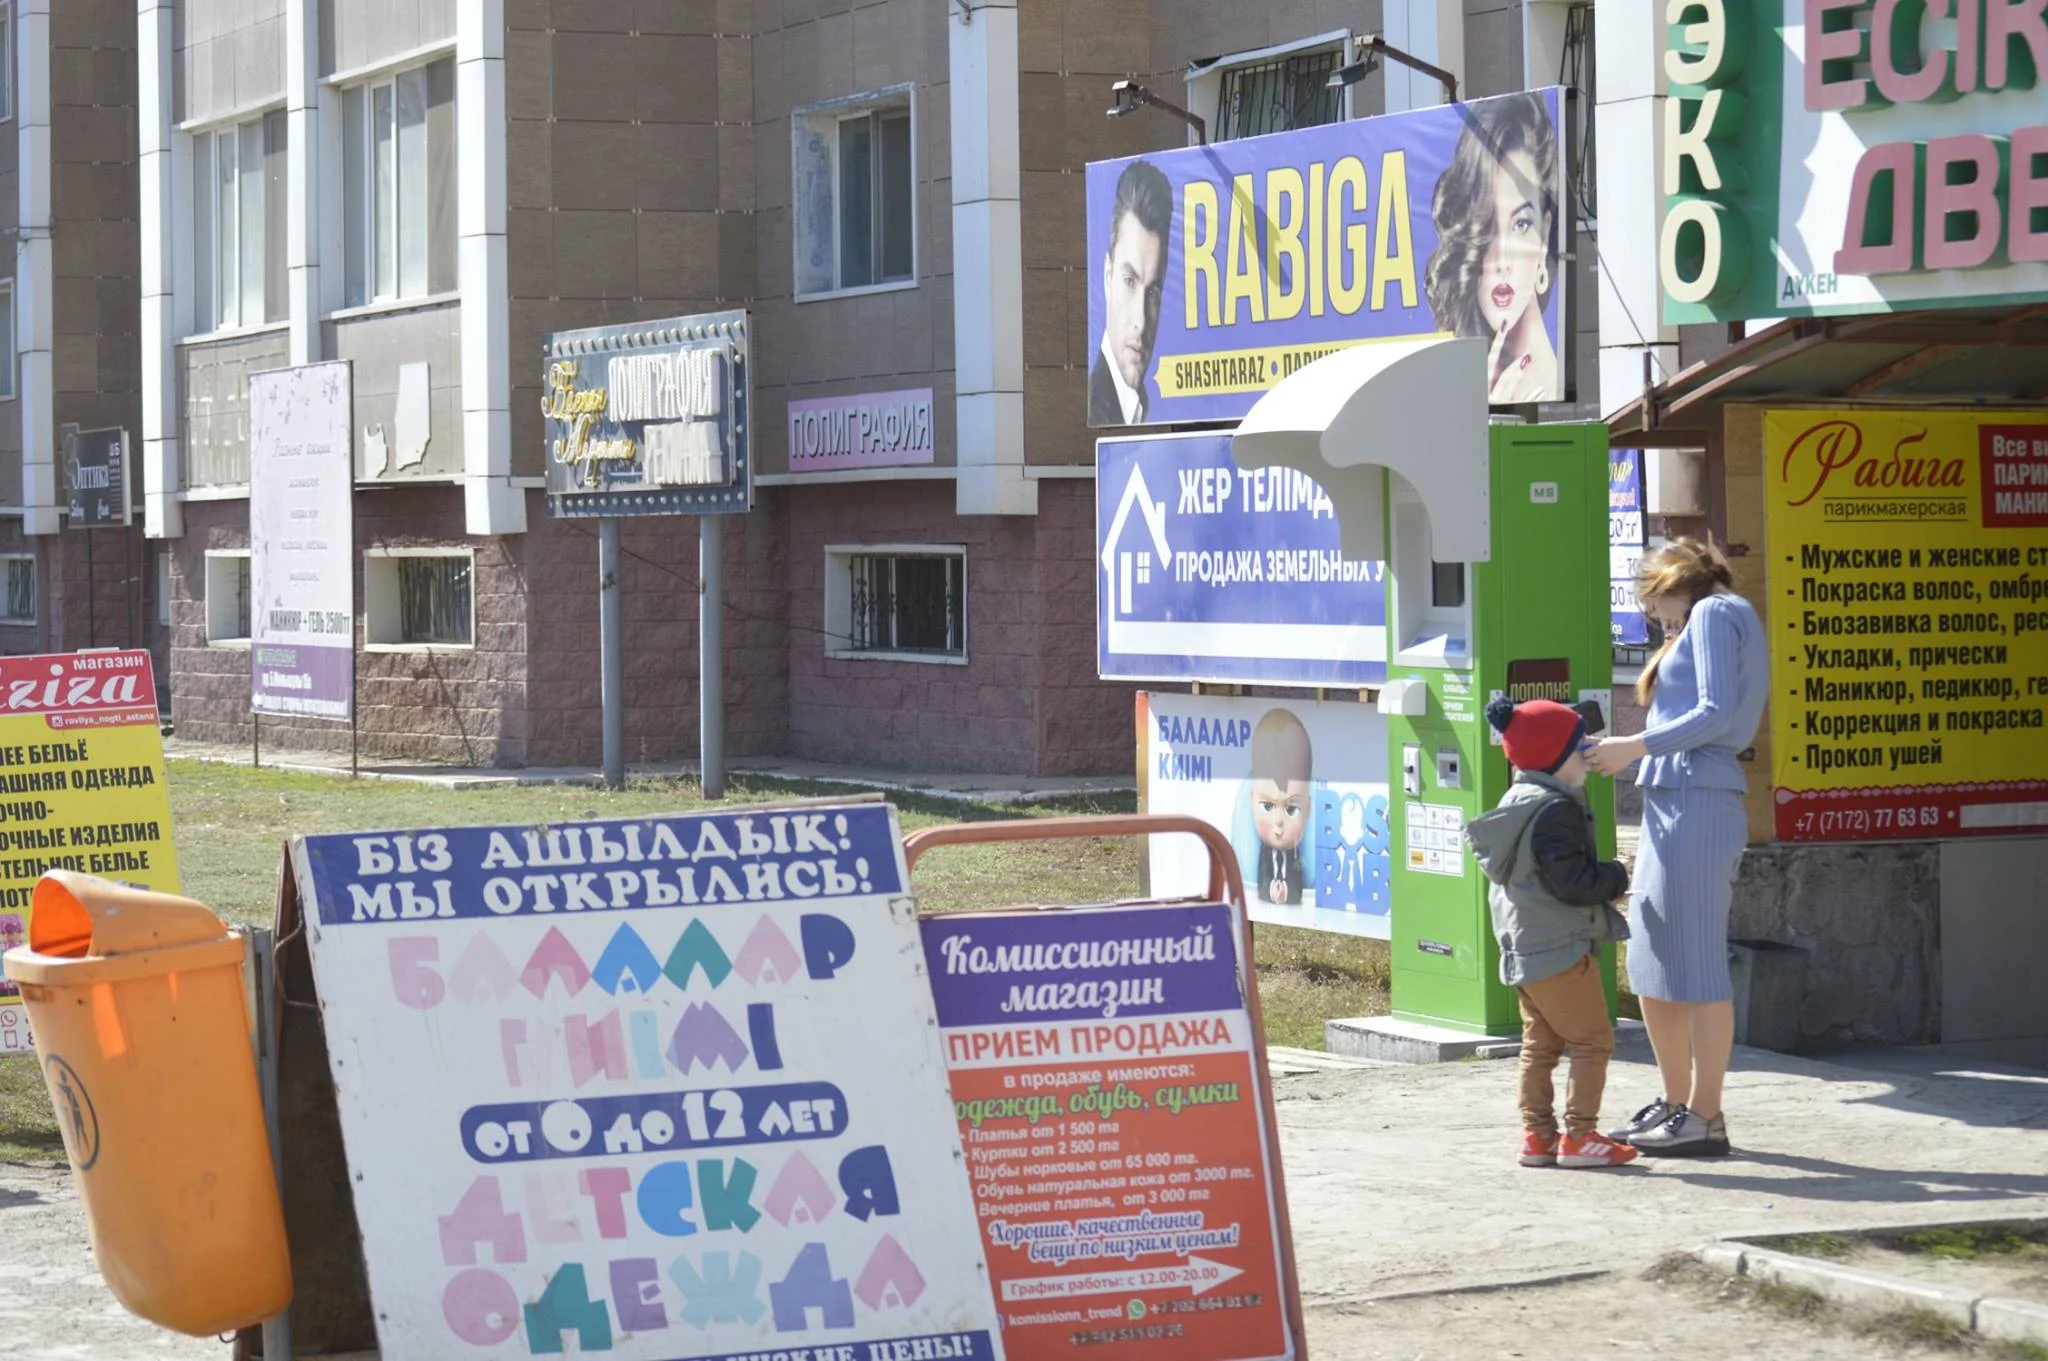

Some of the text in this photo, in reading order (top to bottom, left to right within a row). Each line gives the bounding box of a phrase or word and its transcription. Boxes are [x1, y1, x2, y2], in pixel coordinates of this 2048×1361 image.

[1660, 0, 1726, 303] ЭКО
[1183, 150, 1418, 330] RABIGA
[1176, 355, 1265, 389] SHASHTARAZ
[791, 402, 931, 458] ПОЛИГРАФИЯ
[1993, 434, 2027, 457] Все
[1783, 420, 1965, 506] Рабига
[1177, 468, 1232, 514] ЖЕР
[1824, 501, 1966, 520] парикмахерская
[1176, 551, 1263, 587] ПРОДАЖА
[1801, 544, 1902, 574] Мужские
[1909, 550, 1921, 568] и
[1928, 547, 2020, 568] женские
[1802, 577, 1905, 607] Покраска
[1913, 579, 1981, 604] волос,
[1803, 611, 1931, 635] Биозавивка
[1938, 612, 2007, 637] волос,
[73, 656, 144, 671] магазин
[1804, 644, 2007, 671] Укладки, прически
[0, 663, 145, 710] ziza
[1805, 677, 1914, 704] Маникюр,
[1922, 676, 2020, 703] педикюр,
[1158, 715, 1252, 747] БАЛАЛАР
[1805, 707, 2043, 739] Коррекция и покраска
[29, 739, 88, 764] БЕЛЬЁ
[1806, 738, 1942, 774] Прокол ушей
[72, 766, 155, 791] ОДЕЖДА
[70, 822, 160, 847] ИЗДЕЛИЯ
[1795, 806, 1938, 834] +7 (7172) 77 63 63
[0, 851, 149, 879] ТЕЛЬНОЕ БЕЛЬЕ
[353, 833, 452, 876] БІЗ
[347, 857, 873, 921] МЫ ОТКРЫЛИСЬ!
[941, 924, 1215, 974] Комиссионный
[1001, 977, 1164, 1018] магазин
[948, 1018, 1232, 1062] ПРИЕМ ПРОДАЖА
[1004, 1064, 1194, 1091] в продаже имеются:
[955, 1080, 1240, 1127] одежда, обувь, сумки
[475, 1121, 531, 1156] ОТ
[604, 1109, 674, 1153] ДО
[681, 1090, 747, 1140] 12
[758, 1098, 838, 1136] ЛЕТ
[969, 1128, 1028, 1144] Платья
[1031, 1126, 1054, 1138] от
[1058, 1124, 1066, 1137] 1
[1070, 1122, 1094, 1136] 500
[972, 1145, 1028, 1163] Куртки
[1031, 1143, 1054, 1157] от
[1058, 1141, 1067, 1155] 2
[1070, 1140, 1094, 1154] 500
[974, 1163, 1018, 1182] Шубы
[1100, 1157, 1122, 1170] от
[1126, 1154, 1142, 1168] 65
[1146, 1153, 1171, 1167] 000
[977, 1182, 1023, 1199] Обувь
[1194, 1167, 1226, 1182] 3000
[437, 1145, 900, 1266] ДЕТСКАЯ
[979, 1199, 1050, 1217] Вечерние
[1161, 1188, 1186, 1202] 000
[1077, 1210, 1201, 1238] качественные
[442, 1232, 927, 1354] ОДЕЖДА
[1010, 1281, 1064, 1298] График
[1069, 1276, 1124, 1292] работы:
[868, 1334, 972, 1361] ЦЕНЫ!
